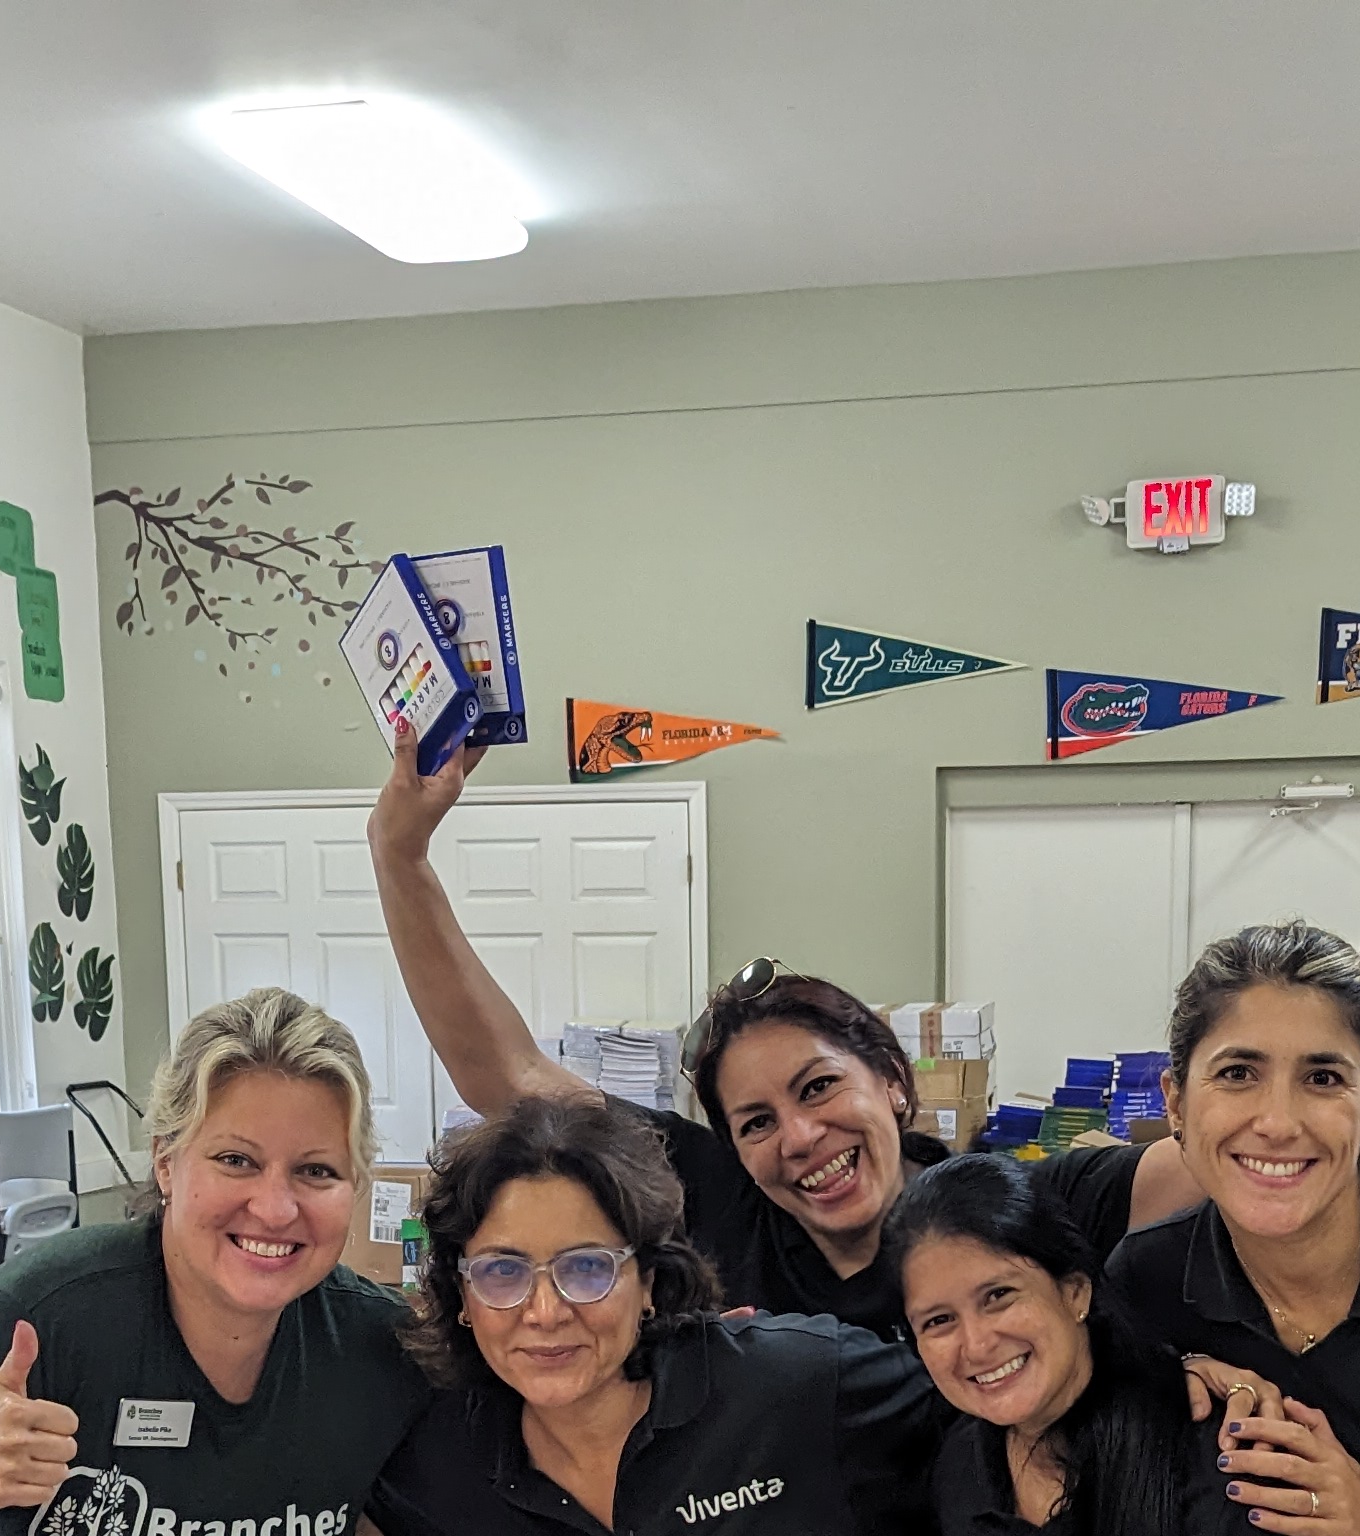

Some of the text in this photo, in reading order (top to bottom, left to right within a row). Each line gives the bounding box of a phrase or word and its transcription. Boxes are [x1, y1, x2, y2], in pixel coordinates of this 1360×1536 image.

[1143, 478, 1213, 537] EXIT
[416, 591, 444, 637] MARKERS
[498, 594, 514, 648] MARKERS
[888, 647, 965, 674] BULLS
[1179, 691, 1228, 704] FLORIDA
[662, 727, 710, 740] FLORIDA
[675, 1477, 785, 1524] Viventa
